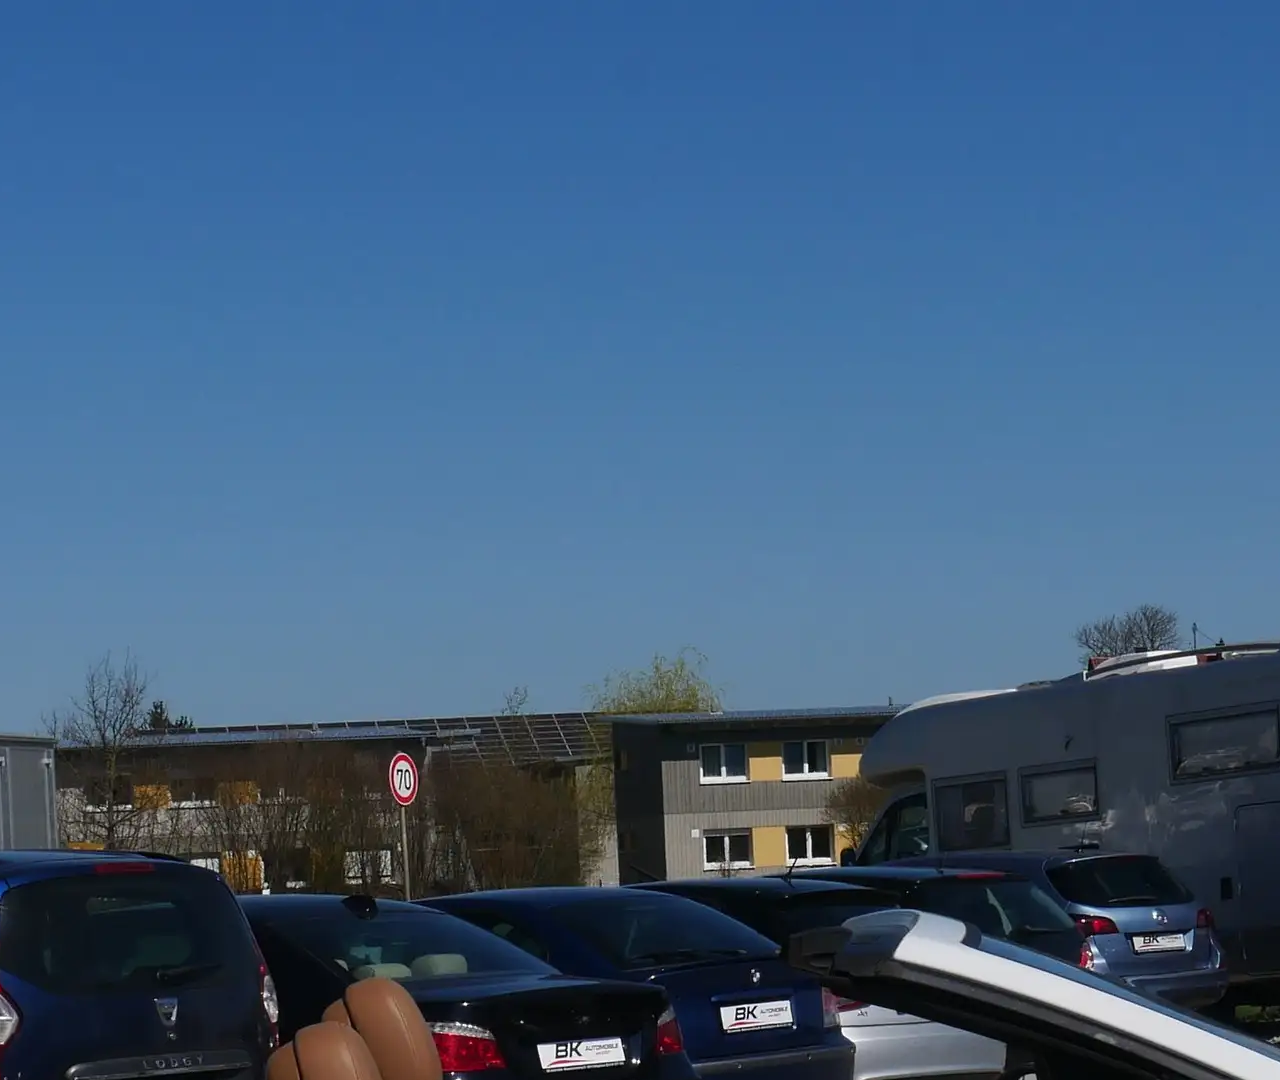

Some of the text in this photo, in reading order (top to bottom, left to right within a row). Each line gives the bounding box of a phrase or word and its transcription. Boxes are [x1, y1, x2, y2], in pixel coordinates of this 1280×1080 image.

[396, 768, 412, 790] 70
[734, 1005, 759, 1021] BK
[555, 1041, 583, 1059] BK
